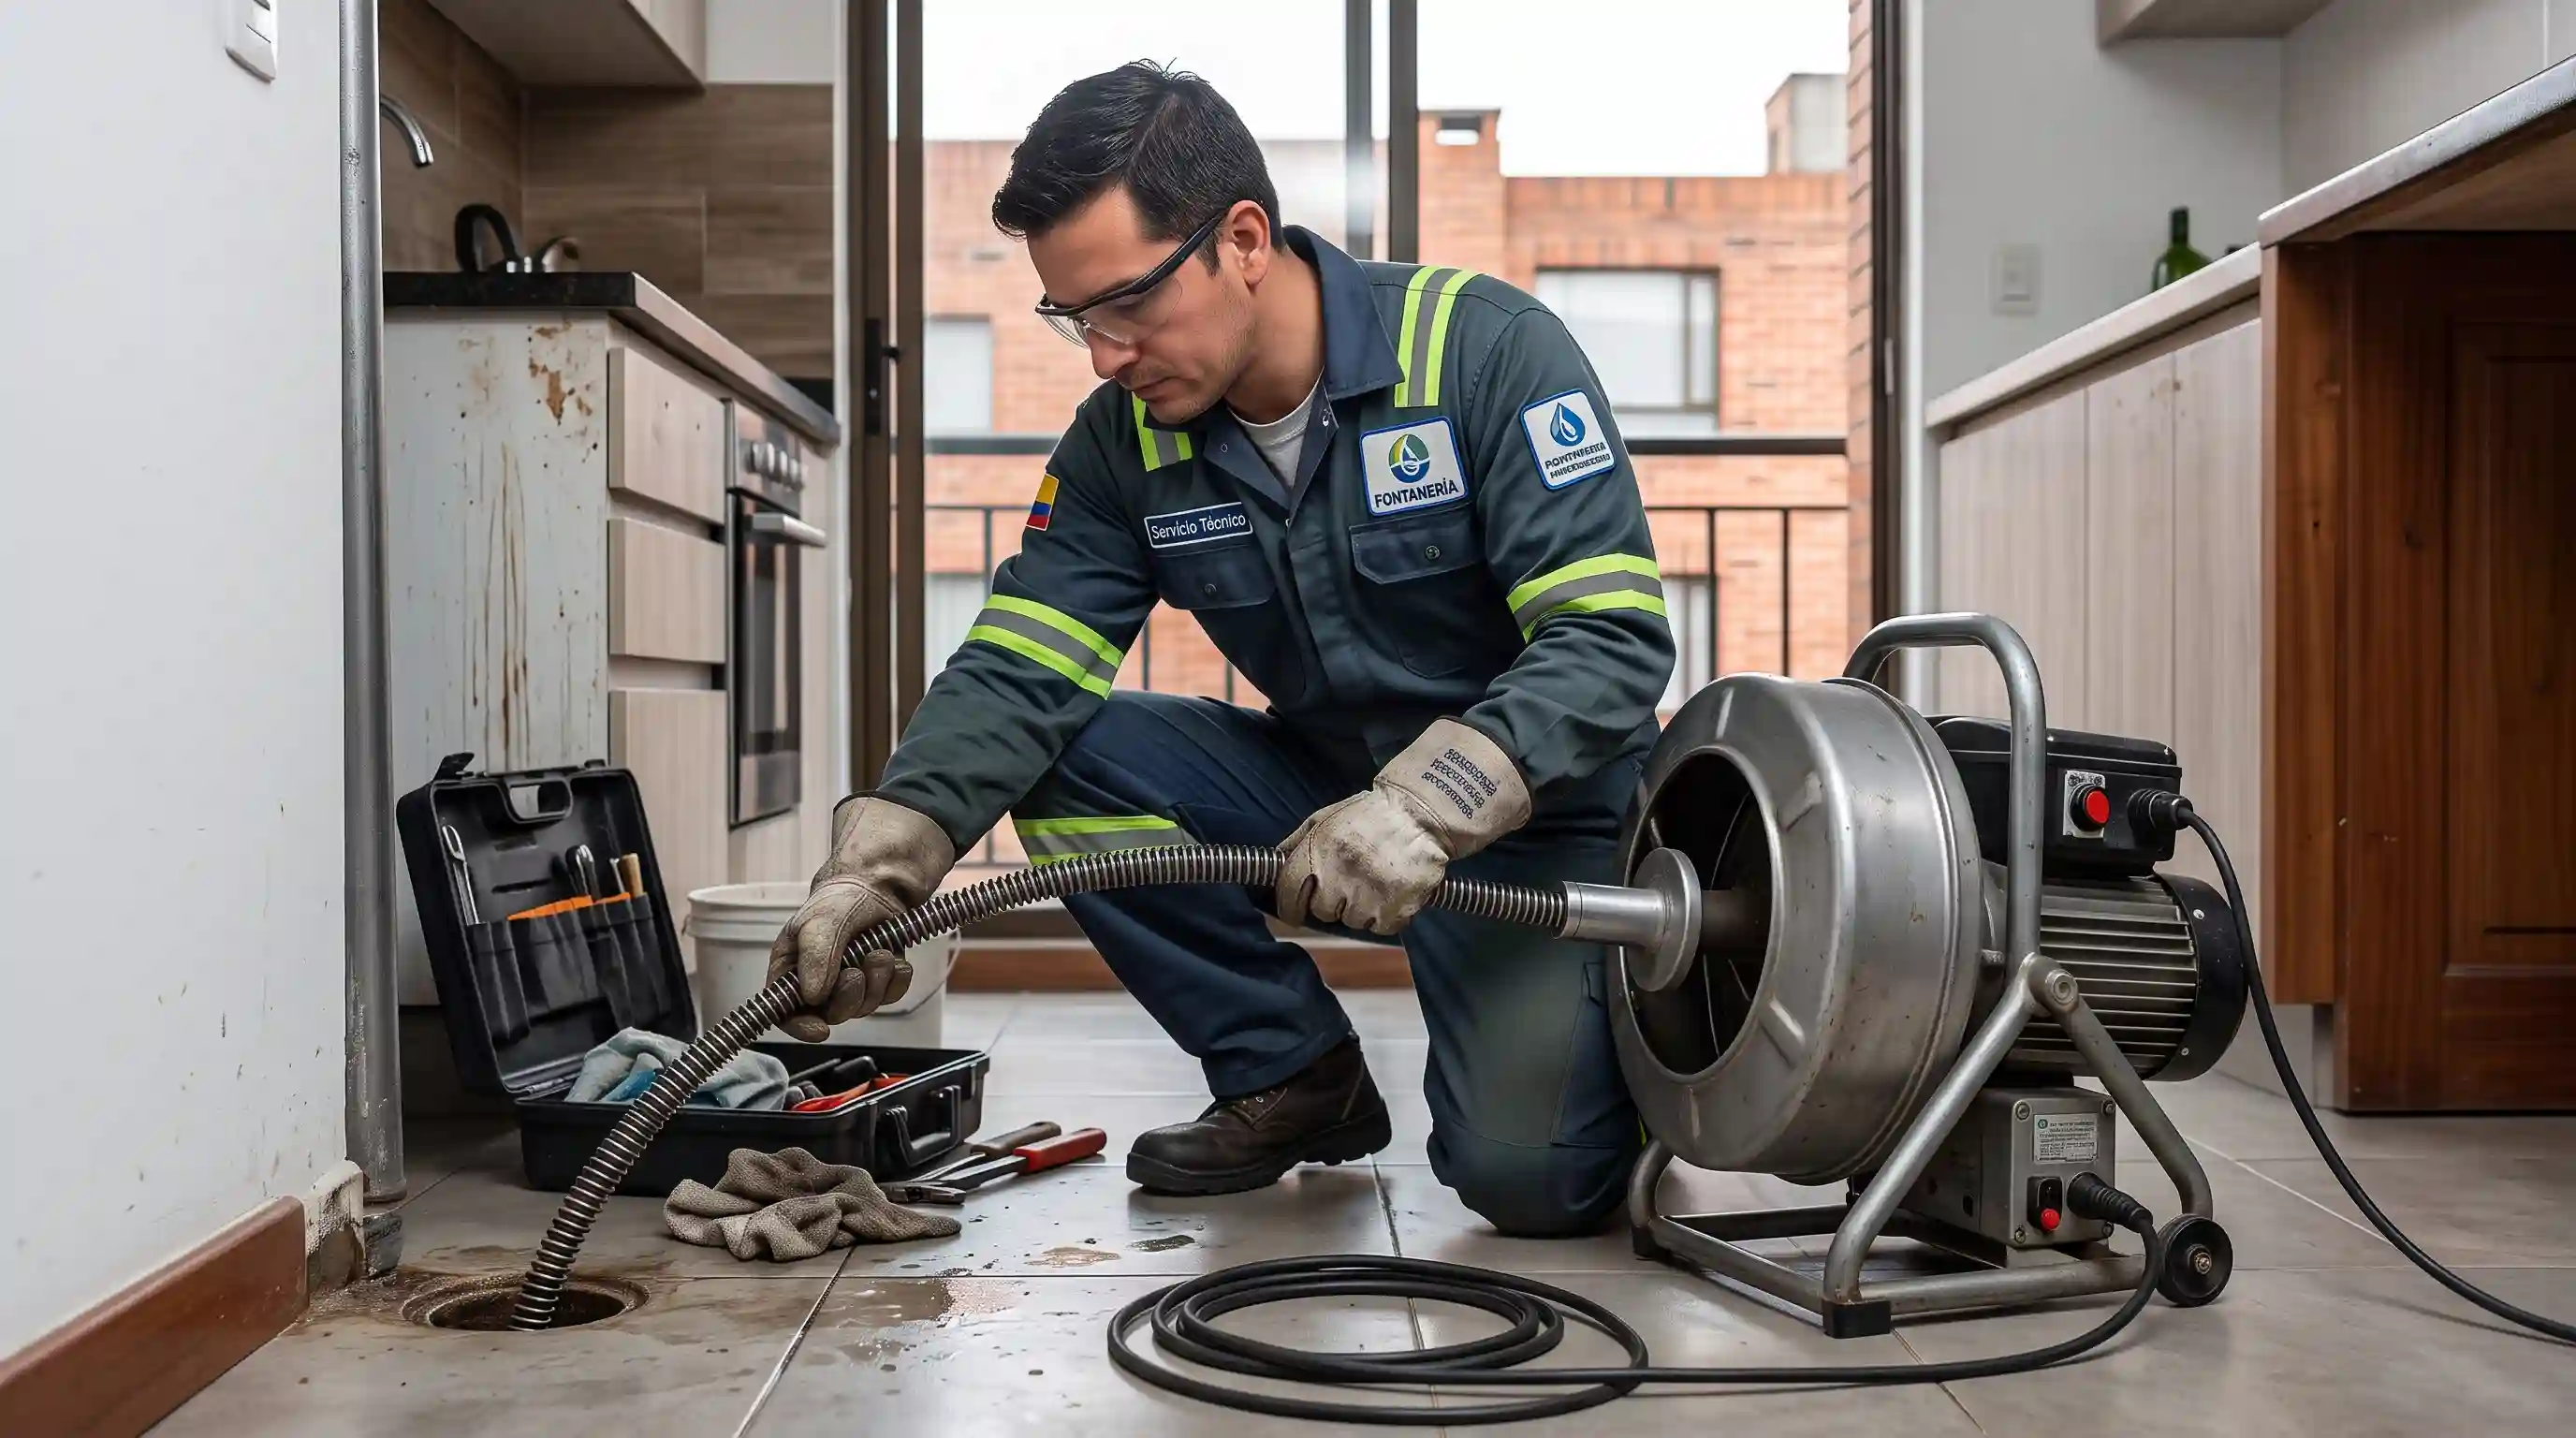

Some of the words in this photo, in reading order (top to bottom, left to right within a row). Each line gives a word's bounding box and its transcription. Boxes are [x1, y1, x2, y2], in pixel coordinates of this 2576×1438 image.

[1374, 477, 1459, 507] FONTANERÍA
[1151, 521, 1197, 539] Servicio
[1199, 514, 1246, 532] Técnico
